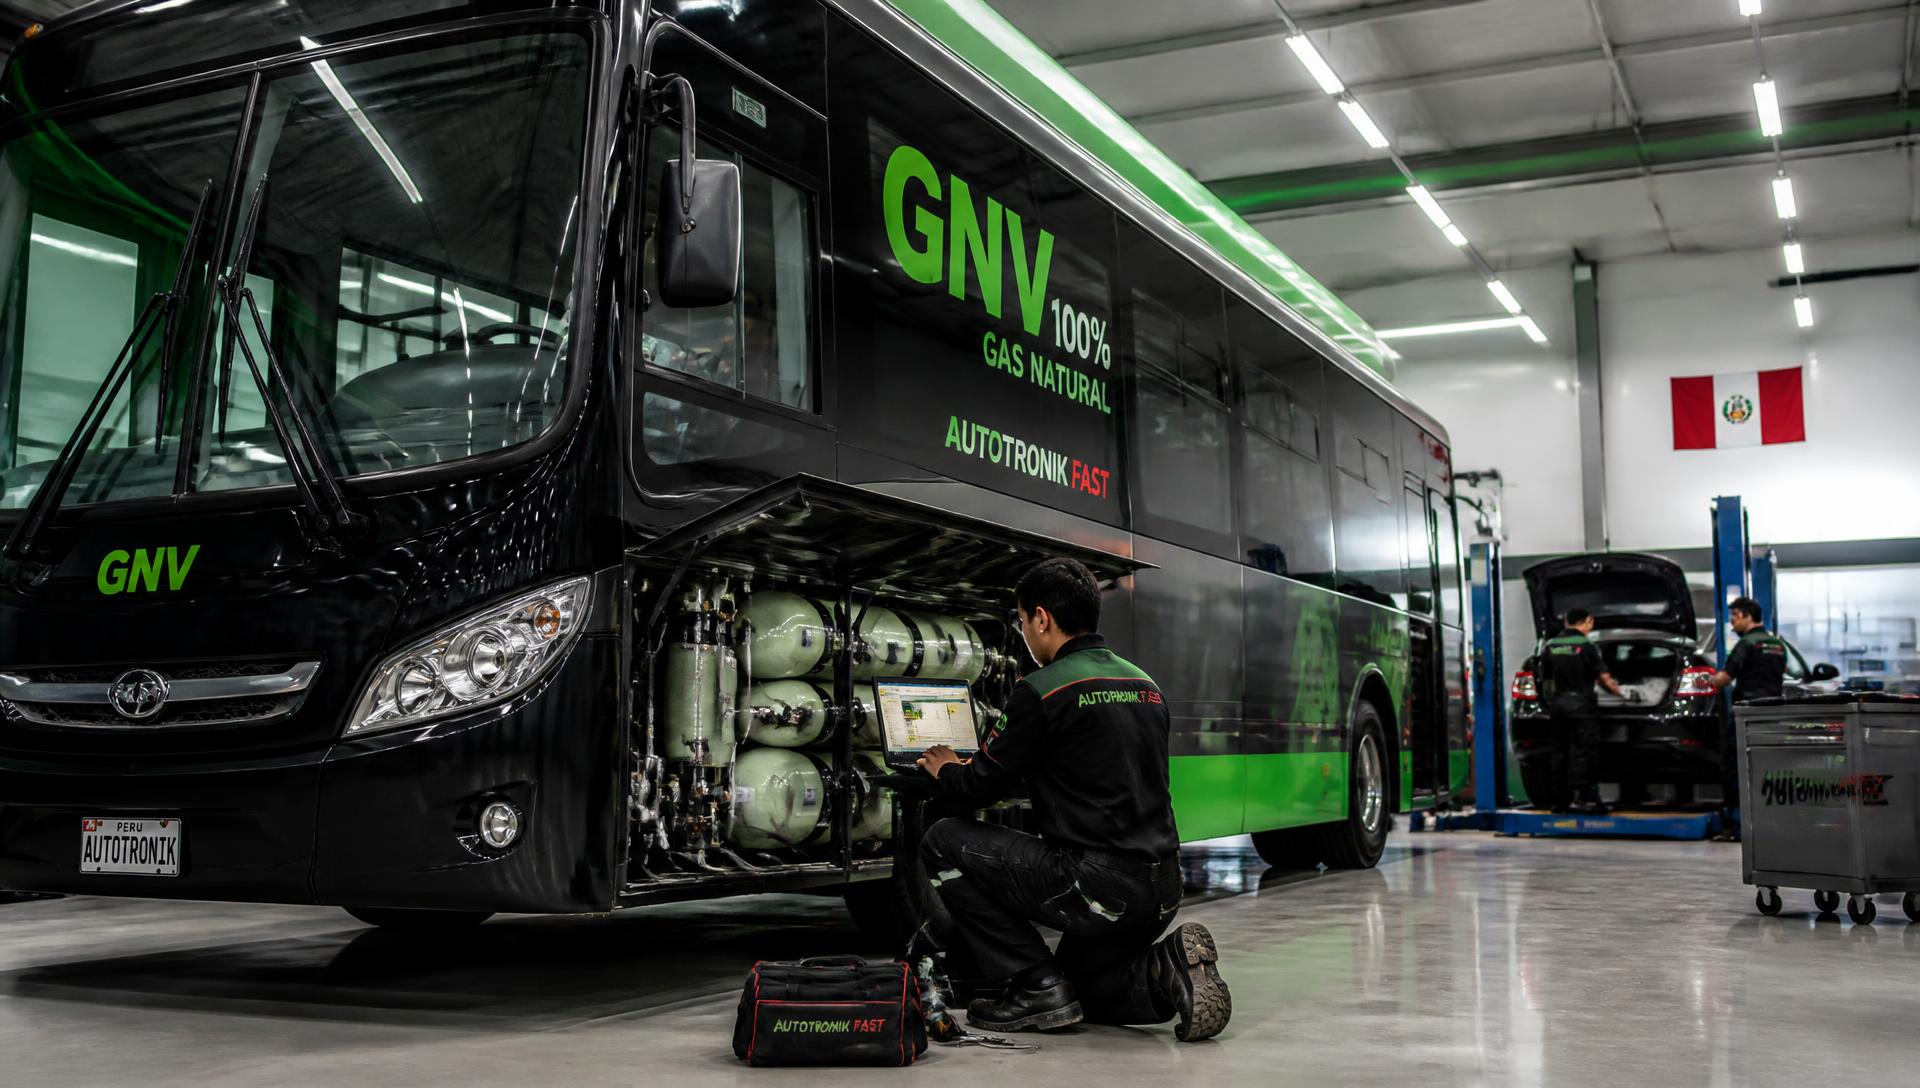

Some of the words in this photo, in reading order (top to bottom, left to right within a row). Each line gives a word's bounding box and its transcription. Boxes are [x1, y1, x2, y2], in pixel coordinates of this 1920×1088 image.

[883, 146, 1053, 337] GNV
[1052, 298, 1111, 371] 100%
[983, 331, 1025, 378] GAS
[1031, 352, 1112, 414] NATURAL
[945, 416, 1068, 486] AUTOTRONIK
[1071, 459, 1111, 498] FAST
[97, 545, 200, 596] GNV
[83, 835, 177, 865] AUTOTRONIK
[116, 822, 143, 832] PERU
